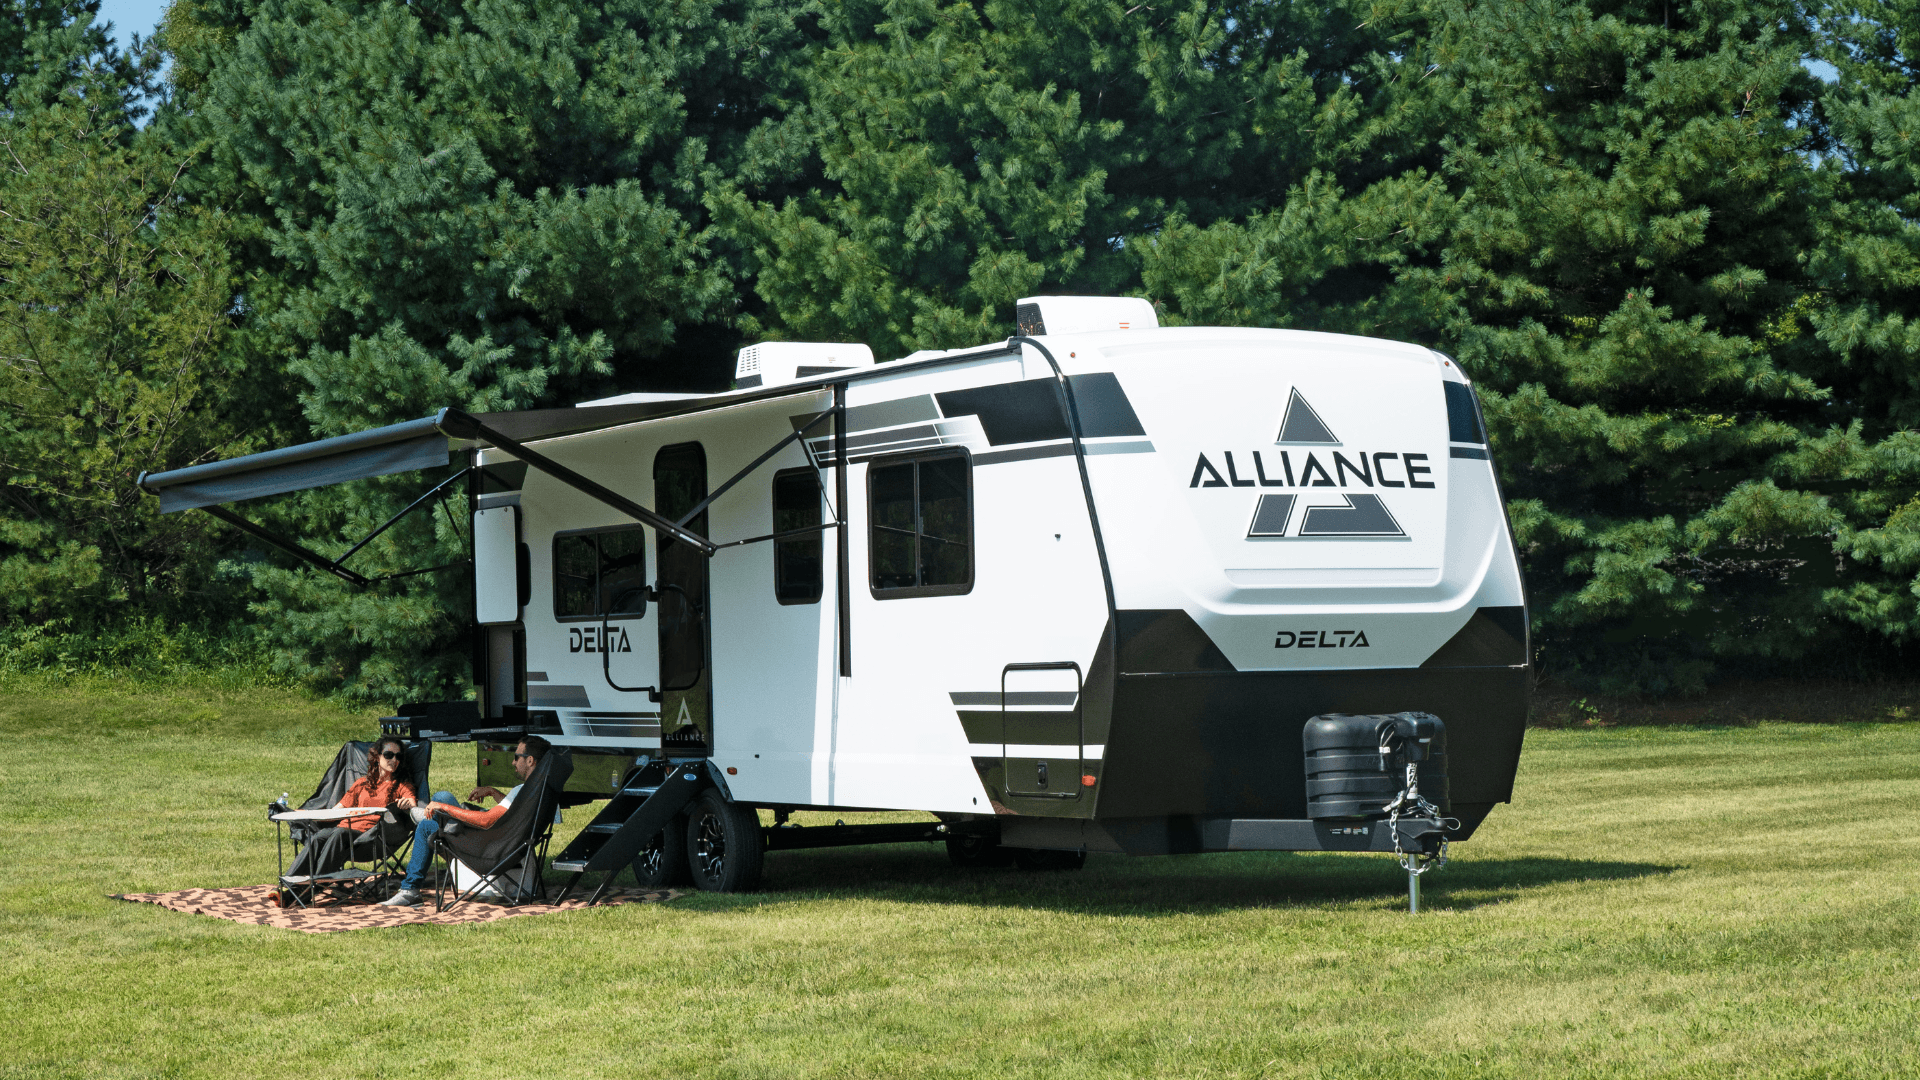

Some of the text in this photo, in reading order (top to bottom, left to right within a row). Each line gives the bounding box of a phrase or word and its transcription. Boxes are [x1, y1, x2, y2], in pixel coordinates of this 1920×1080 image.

[1190, 451, 1435, 488] ALLIANCE
[570, 626, 631, 652] DELTA
[1275, 631, 1369, 648] DELTA
[666, 733, 705, 742] ALLIANCE
